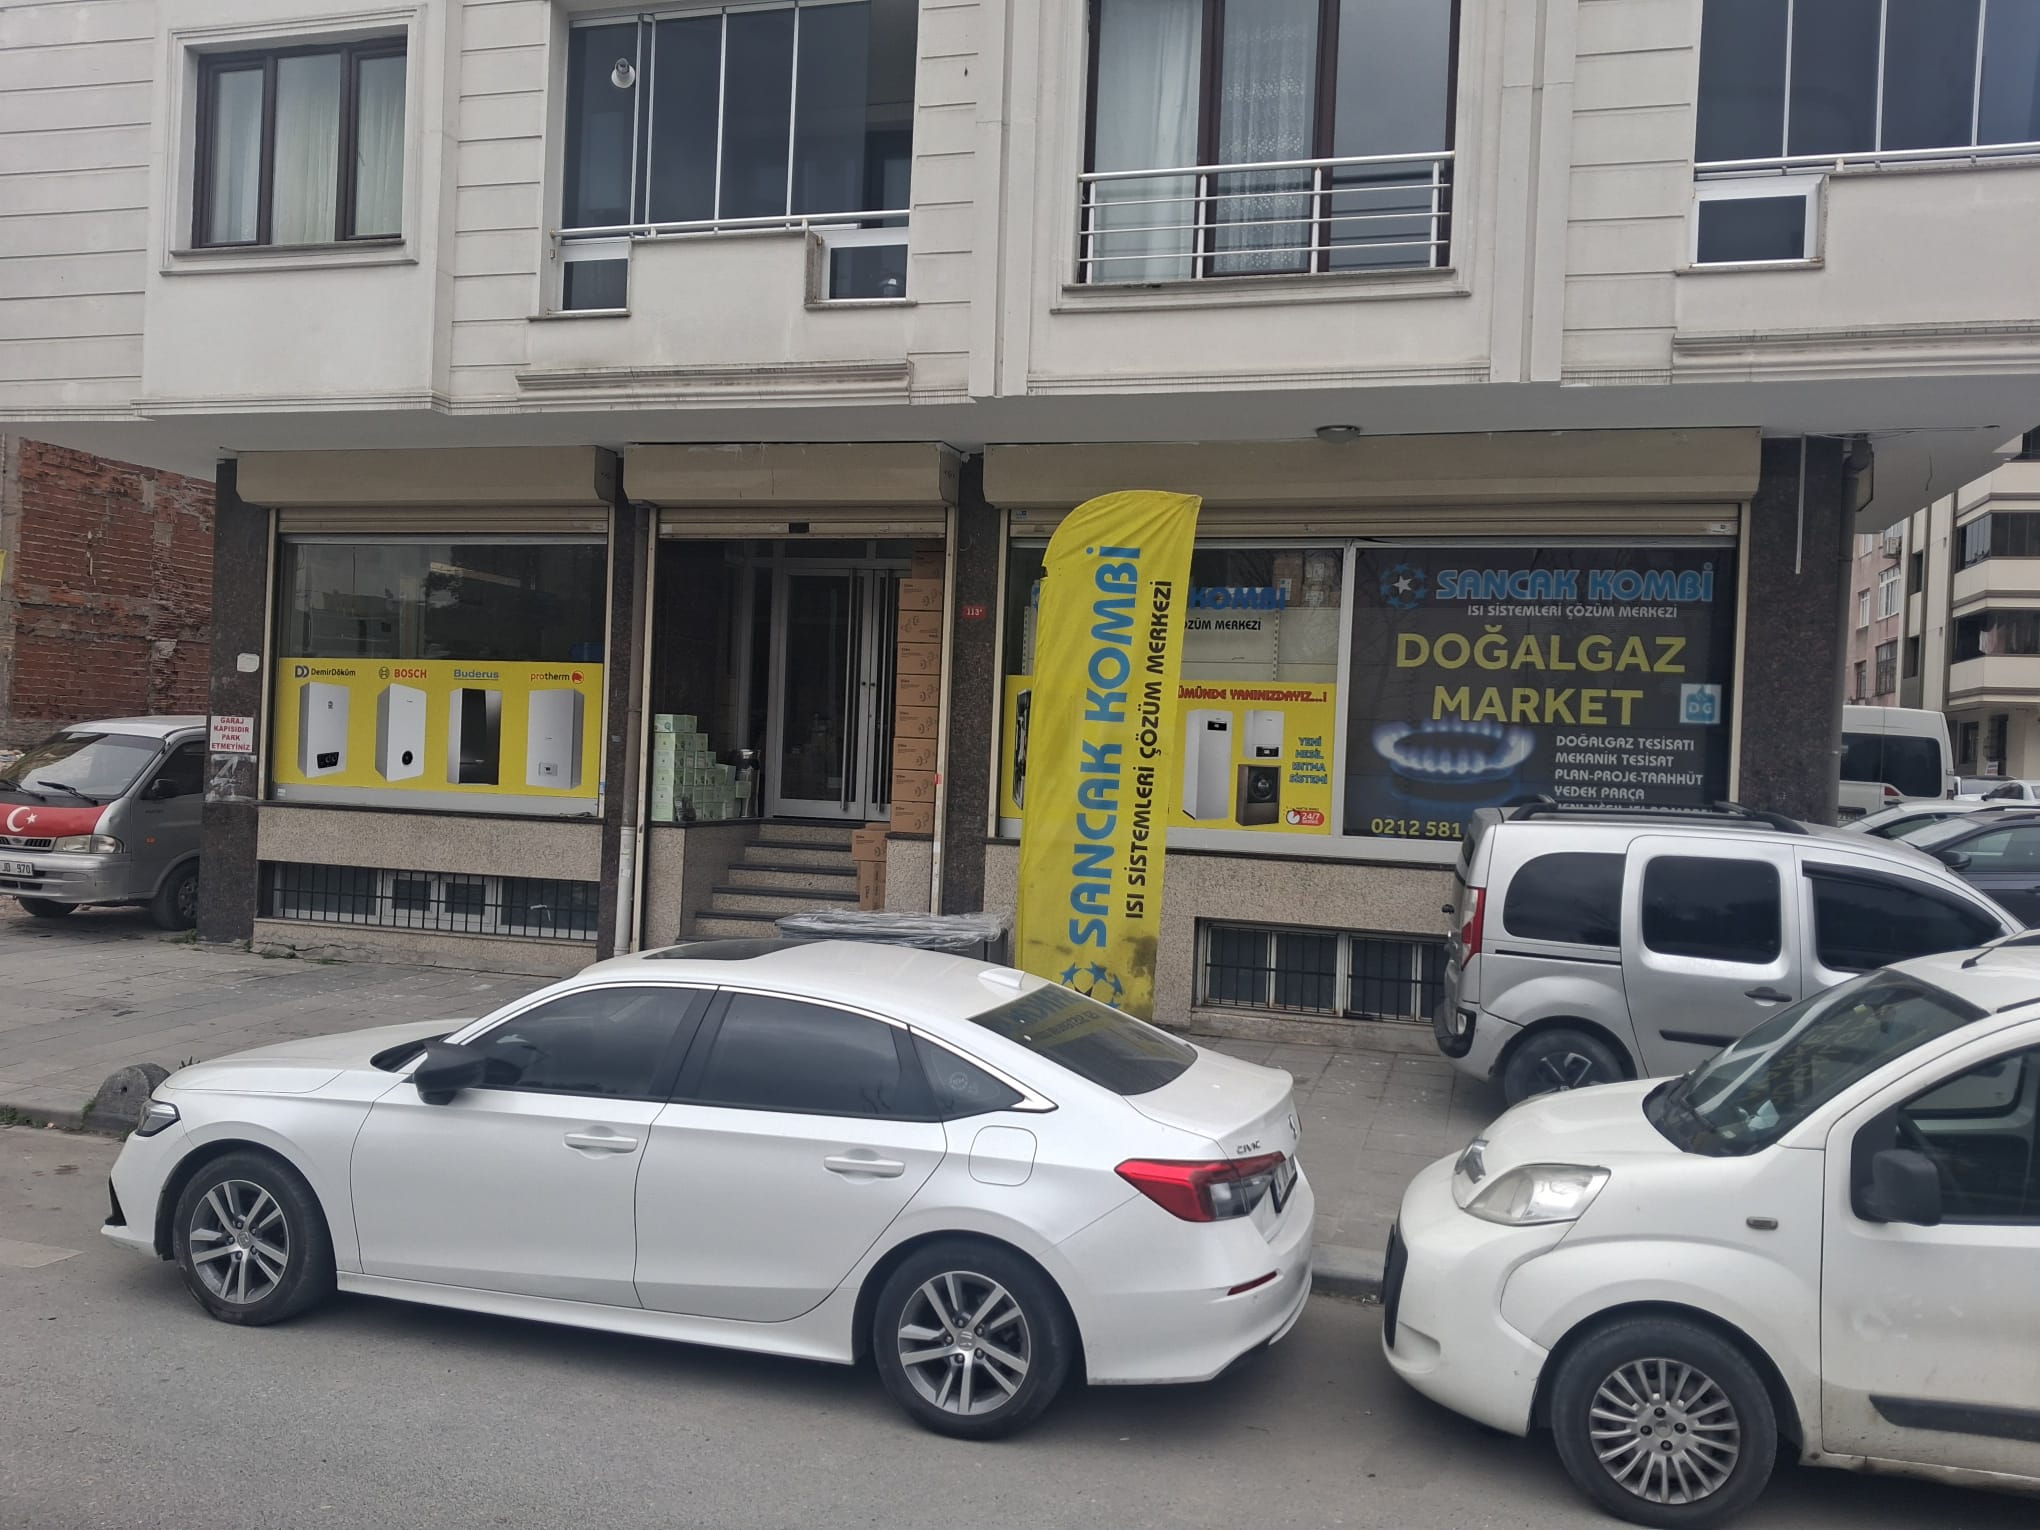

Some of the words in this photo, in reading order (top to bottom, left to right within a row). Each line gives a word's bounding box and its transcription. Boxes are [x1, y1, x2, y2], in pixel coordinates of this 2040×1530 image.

[1435, 569, 1580, 600] SANCAK
[1587, 562, 1714, 602] KOMBİ
[1467, 605, 1484, 616] ISI
[1487, 603, 1562, 616] SİSTEMLERİ
[1566, 604, 1615, 619] ÇÖZÜM
[1618, 604, 1677, 617] MERKEZİ
[1146, 580, 1172, 674] MERKEZİ
[1214, 618, 1261, 630] MERKEZİ
[1084, 546, 1141, 723] KOMBİ
[1396, 624, 1687, 673] DOĞALGAZ
[311, 667, 356, 677] DemirDöküm
[394, 668, 427, 679] BOSCH
[453, 669, 499, 678] Buderus
[530, 672, 570, 682] protherm
[1432, 685, 1643, 725] MARKET
[220, 717, 244, 725] GARAJ
[1135, 681, 1163, 759] ÇÖZÜM
[213, 725, 250, 733] KAPISIDIR
[211, 742, 251, 751] ETMEYİNİZ
[1556, 734, 1634, 749] DOĞALGAZ
[1637, 736, 1695, 751] TESİSATI
[1555, 751, 1618, 765] MEKANİK
[1621, 752, 1674, 768] TESİSAT
[1554, 768, 1704, 786] PLAN-PROJE-TAAHHÜT
[1554, 785, 1597, 798] YEDEK
[1601, 787, 1645, 802] PARÇA
[1301, 812, 1320, 820] 24/7
[1124, 766, 1155, 886] SİSTEMLERİ
[1371, 818, 1420, 836] 0212
[1425, 821, 1462, 838] 581
[1069, 739, 1123, 947] SANCAK
[16, 863, 31, 874] 970
[1125, 893, 1145, 918] ISI
